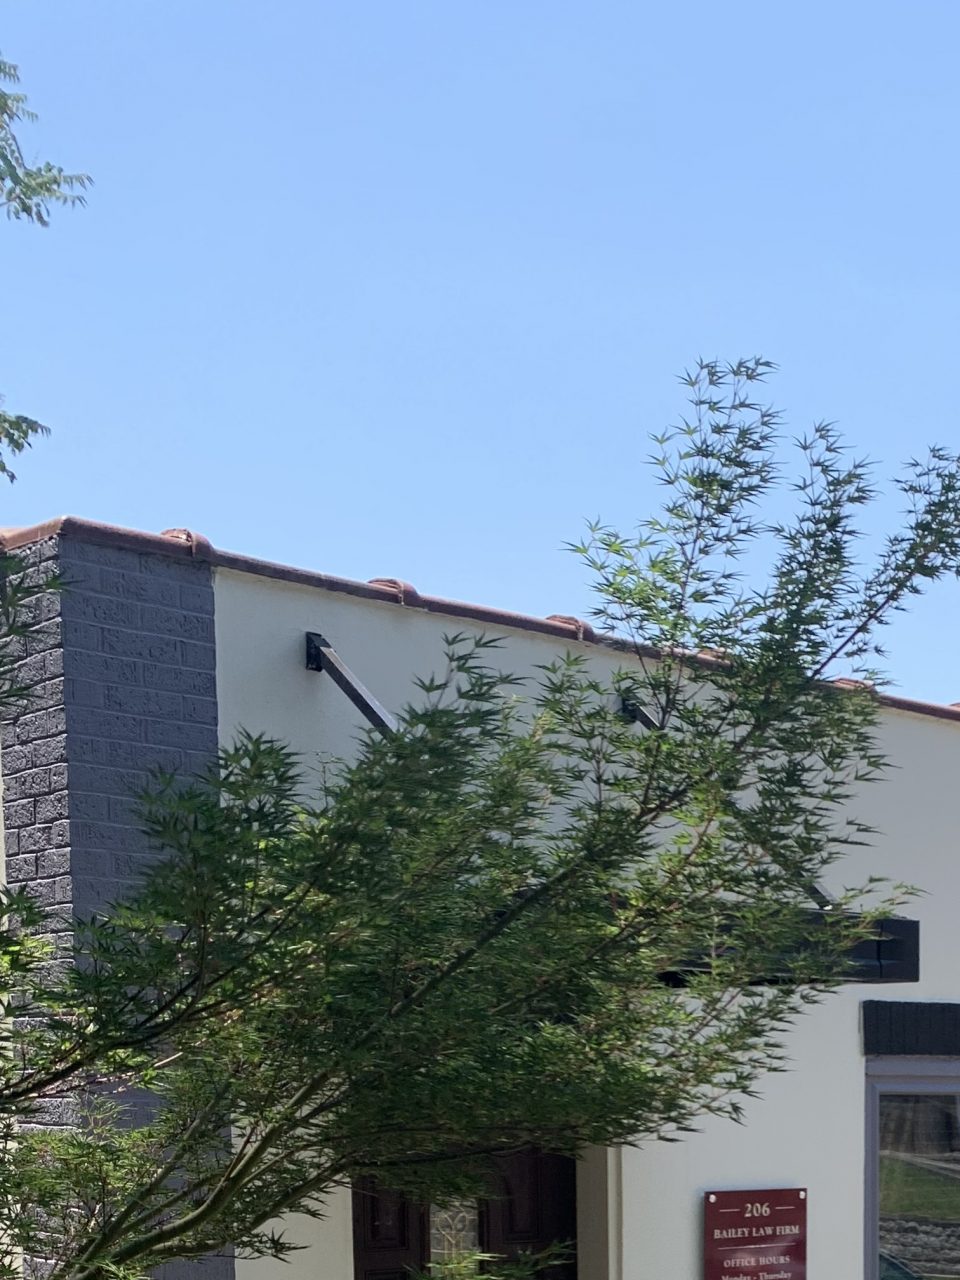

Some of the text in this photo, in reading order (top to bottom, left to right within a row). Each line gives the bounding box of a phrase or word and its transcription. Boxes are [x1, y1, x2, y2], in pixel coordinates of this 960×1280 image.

[744, 1202, 771, 1217] 206
[714, 1225, 800, 1239] BAILEY LAW FIRM
[723, 1255, 790, 1268] OFFICE HOURS
[758, 1271, 792, 1280] Thursday
